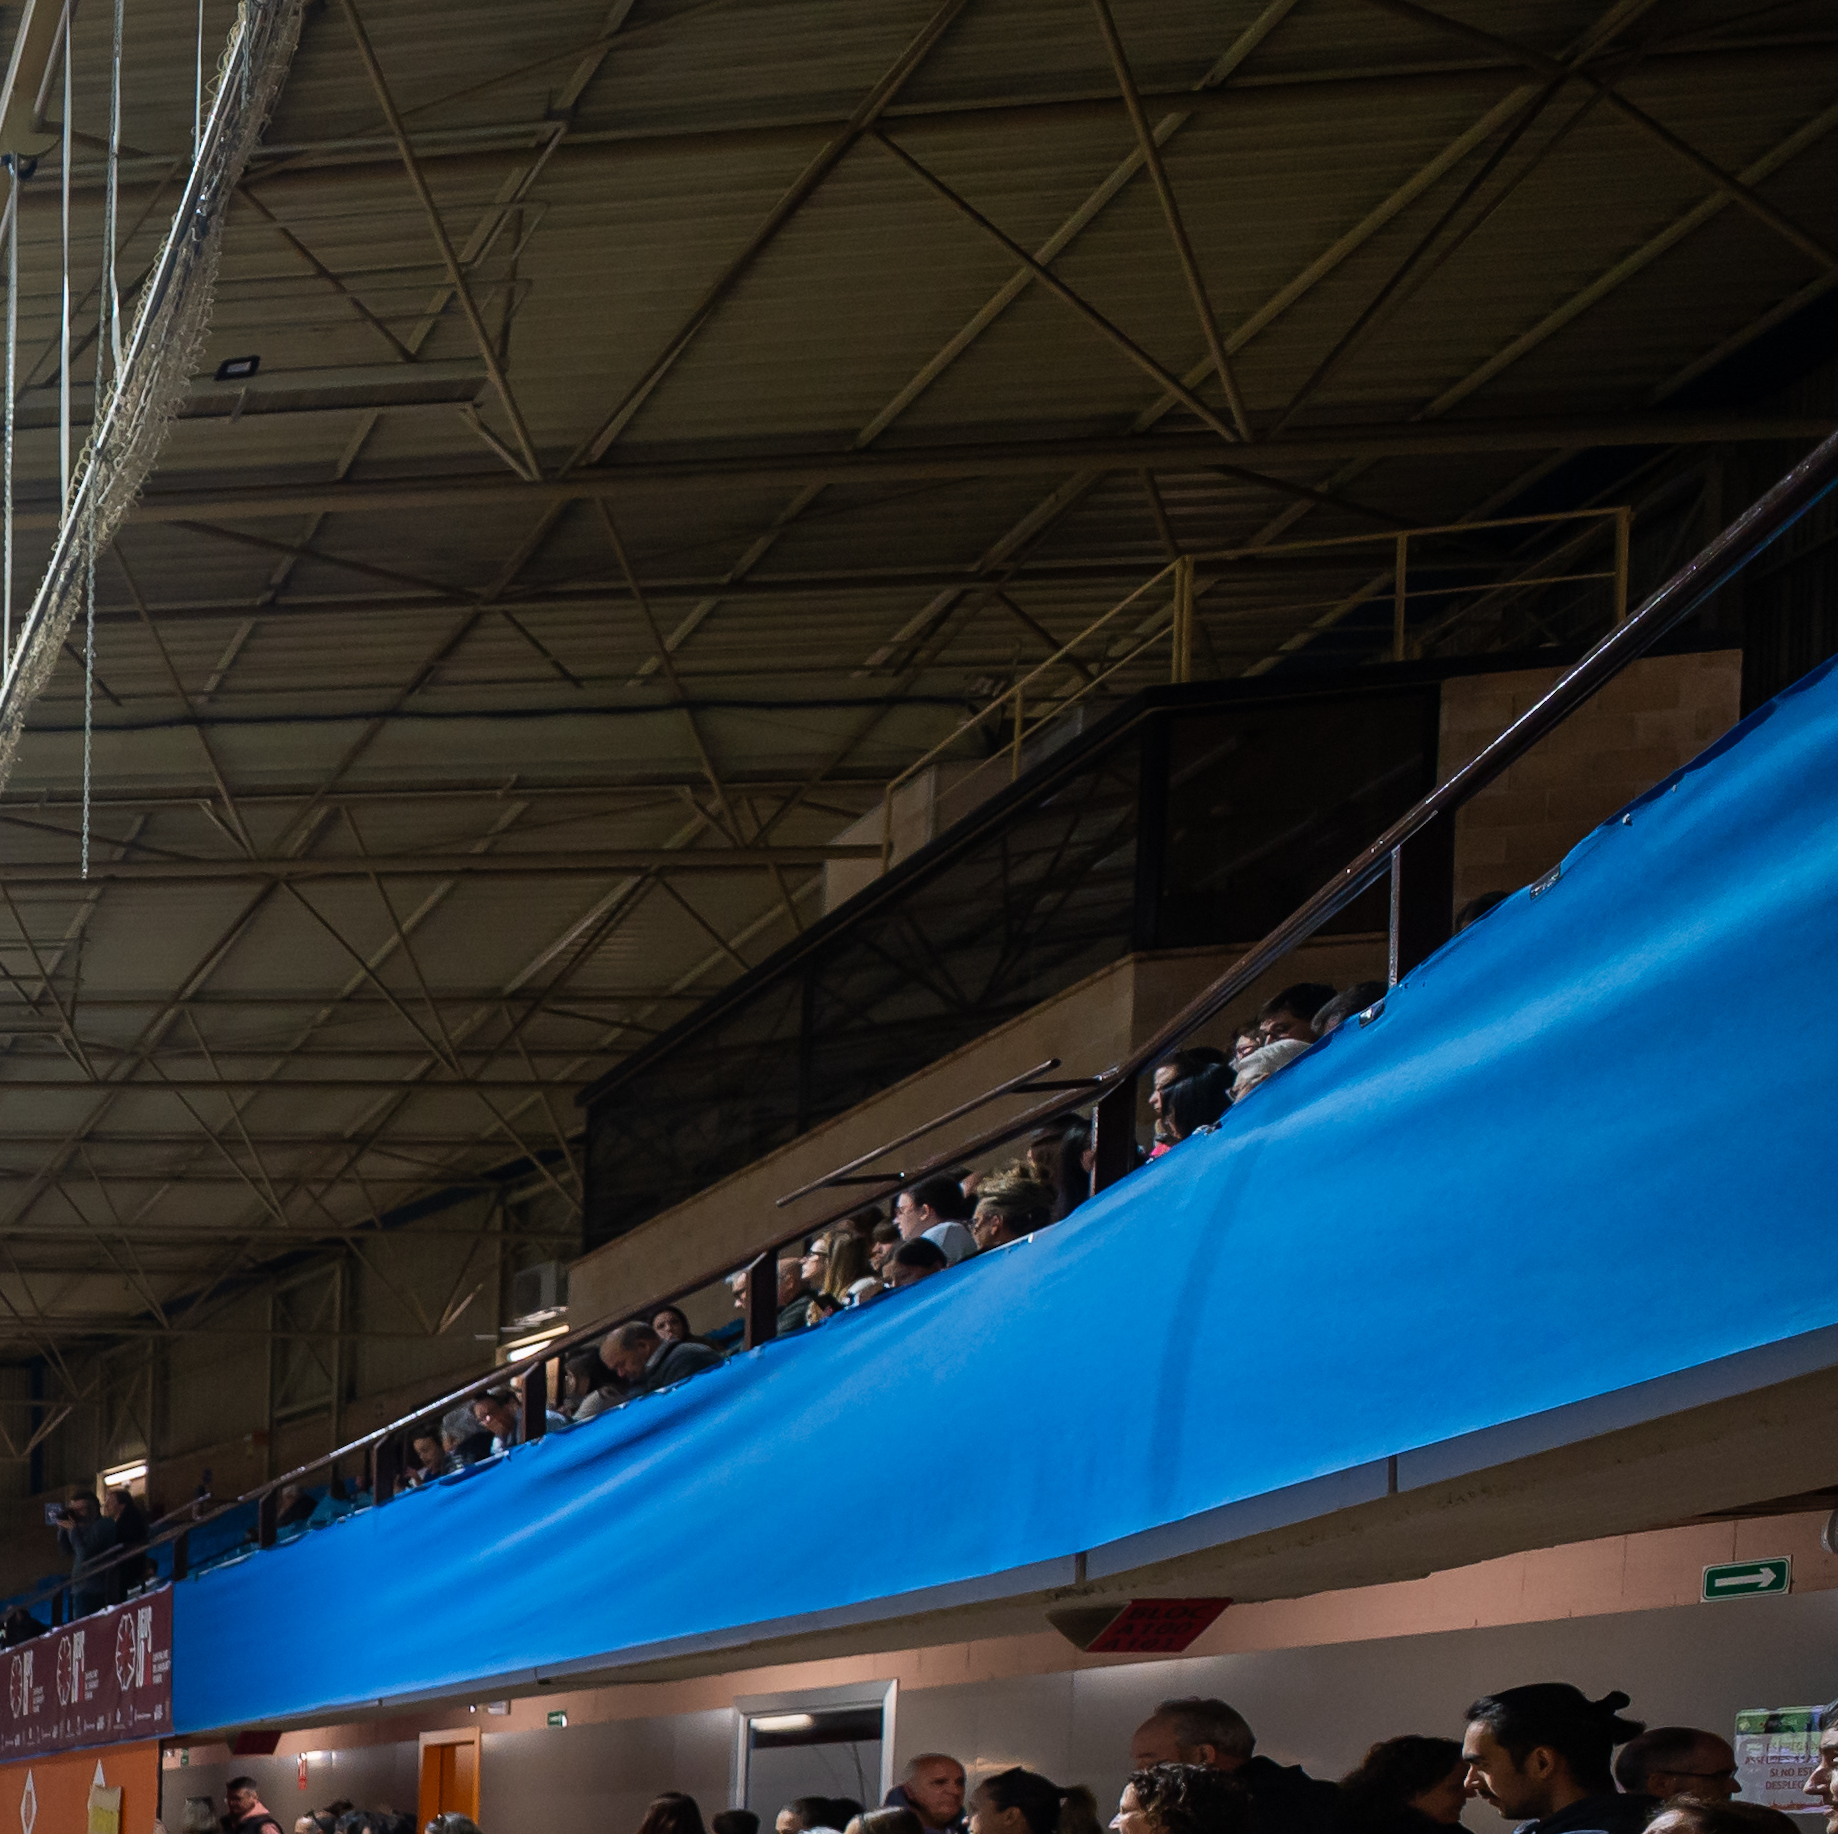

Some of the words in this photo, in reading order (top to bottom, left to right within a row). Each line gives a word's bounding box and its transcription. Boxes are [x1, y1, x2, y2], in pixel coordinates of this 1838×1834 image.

[1128, 1606, 1212, 1620] BLOC
[1115, 1622, 1193, 1635] A100
[1781, 1767, 1795, 1777] NO
[1798, 1766, 1812, 1776] EST
[1765, 1781, 1804, 1790] DESPLEG
